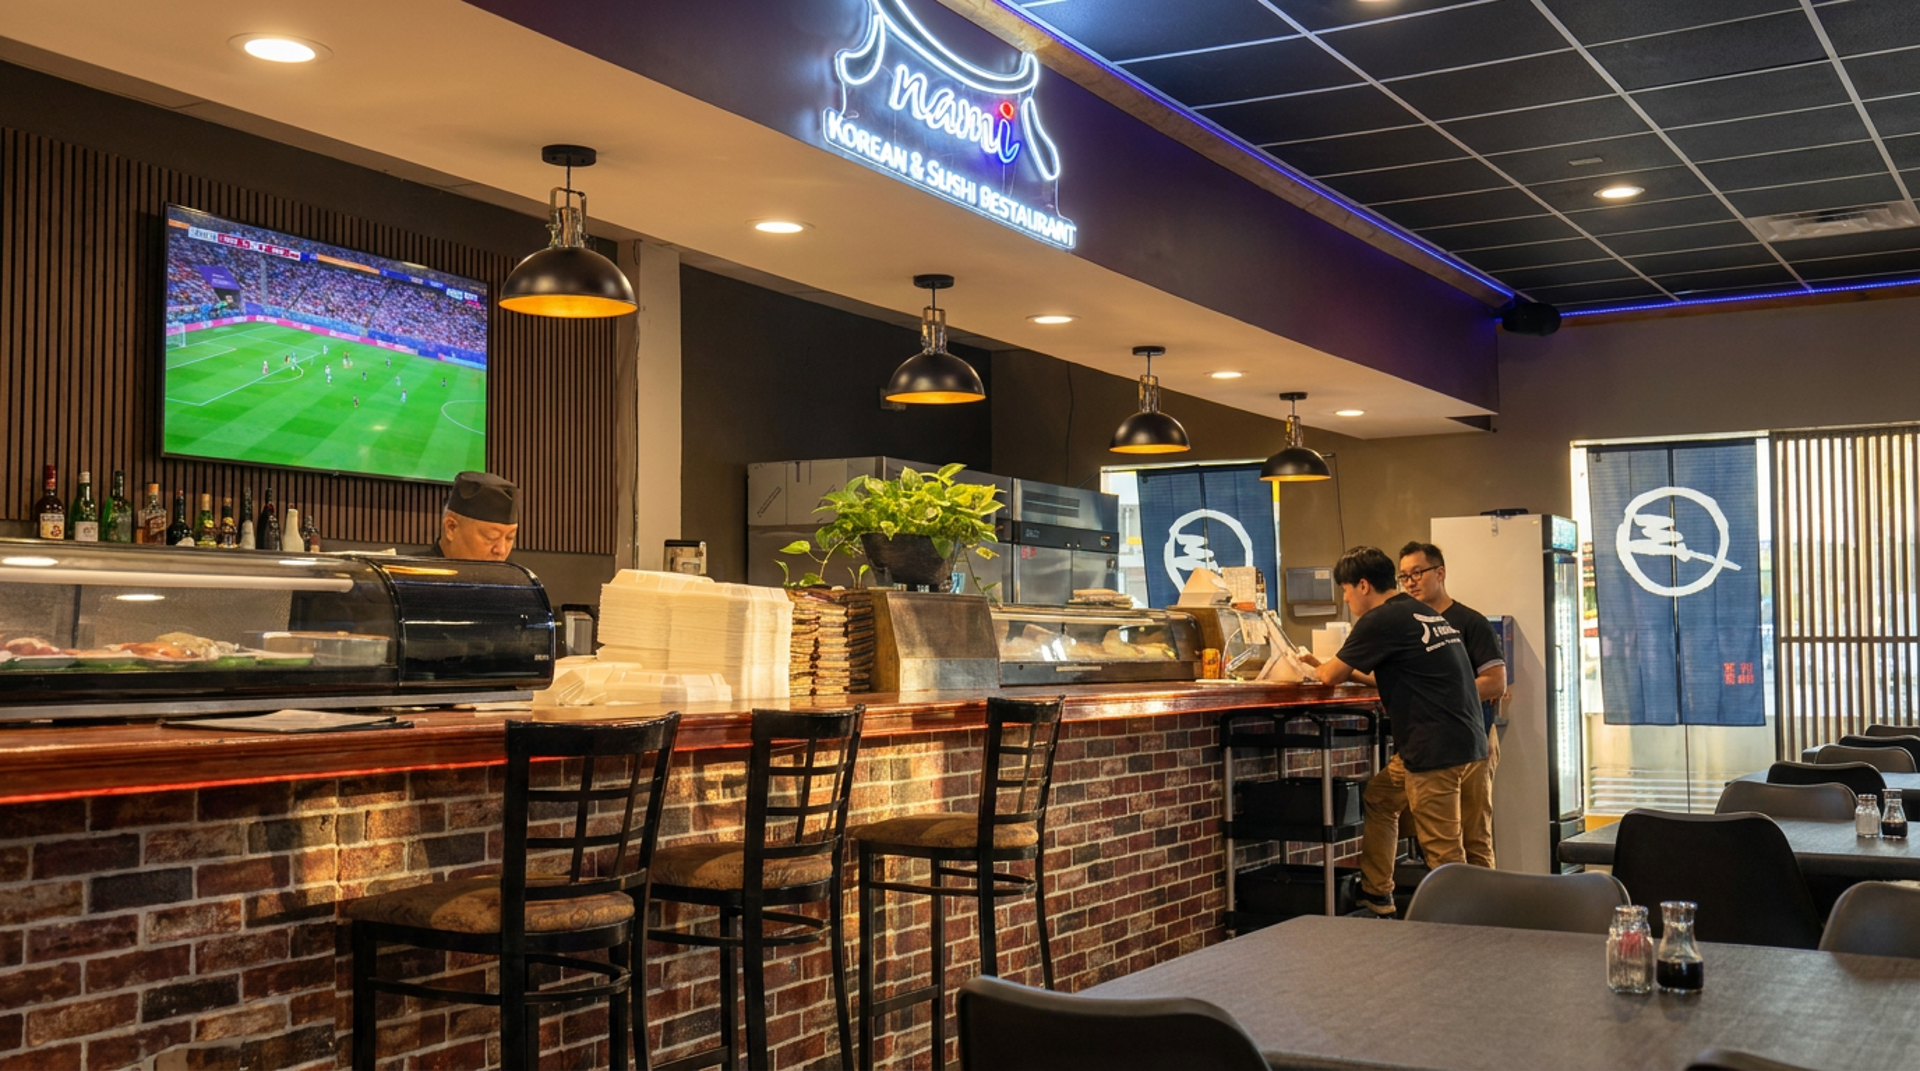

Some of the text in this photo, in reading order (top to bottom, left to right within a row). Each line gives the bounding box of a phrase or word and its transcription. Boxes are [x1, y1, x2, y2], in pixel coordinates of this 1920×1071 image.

[889, 63, 1020, 163] nami
[828, 111, 1077, 247] KOREAN & SUSHI RESTAURANT
